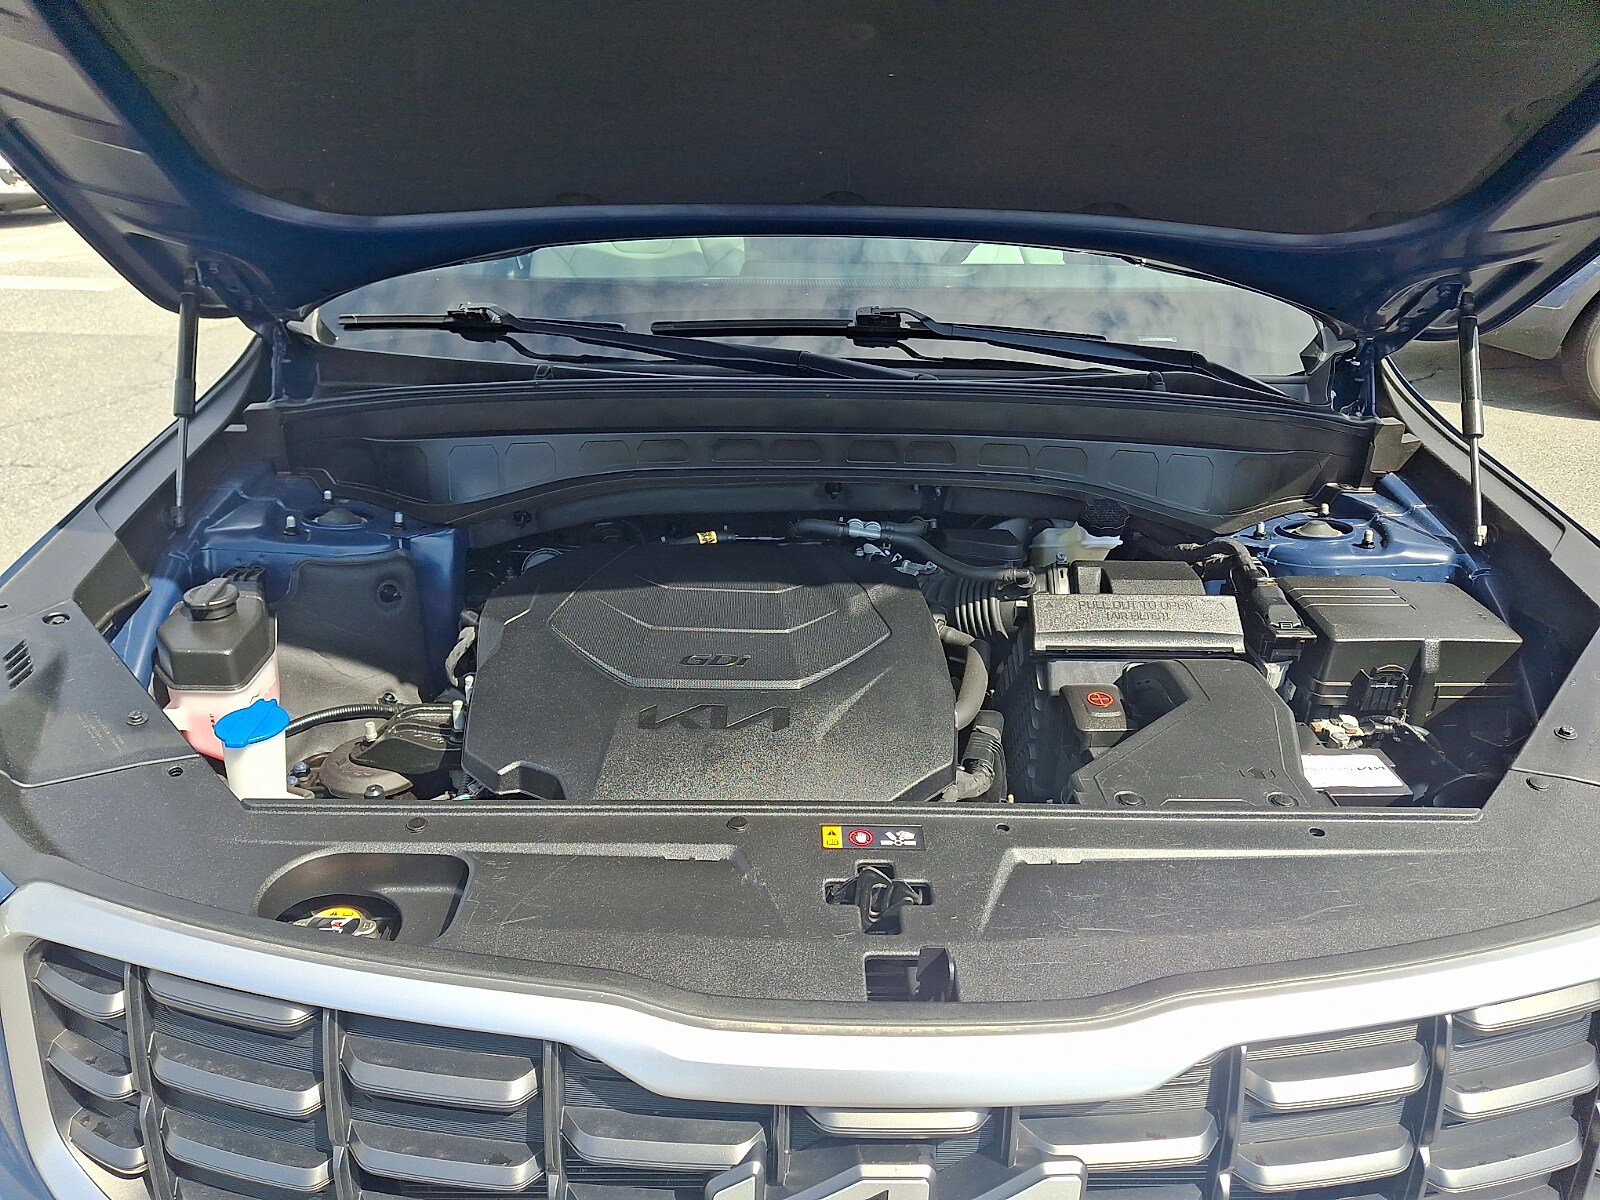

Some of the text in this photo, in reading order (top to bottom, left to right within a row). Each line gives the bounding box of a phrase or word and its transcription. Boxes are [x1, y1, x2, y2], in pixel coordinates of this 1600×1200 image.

[1078, 600, 1194, 611] PULL OUT TO OPEN
[638, 703, 790, 732] KIA
